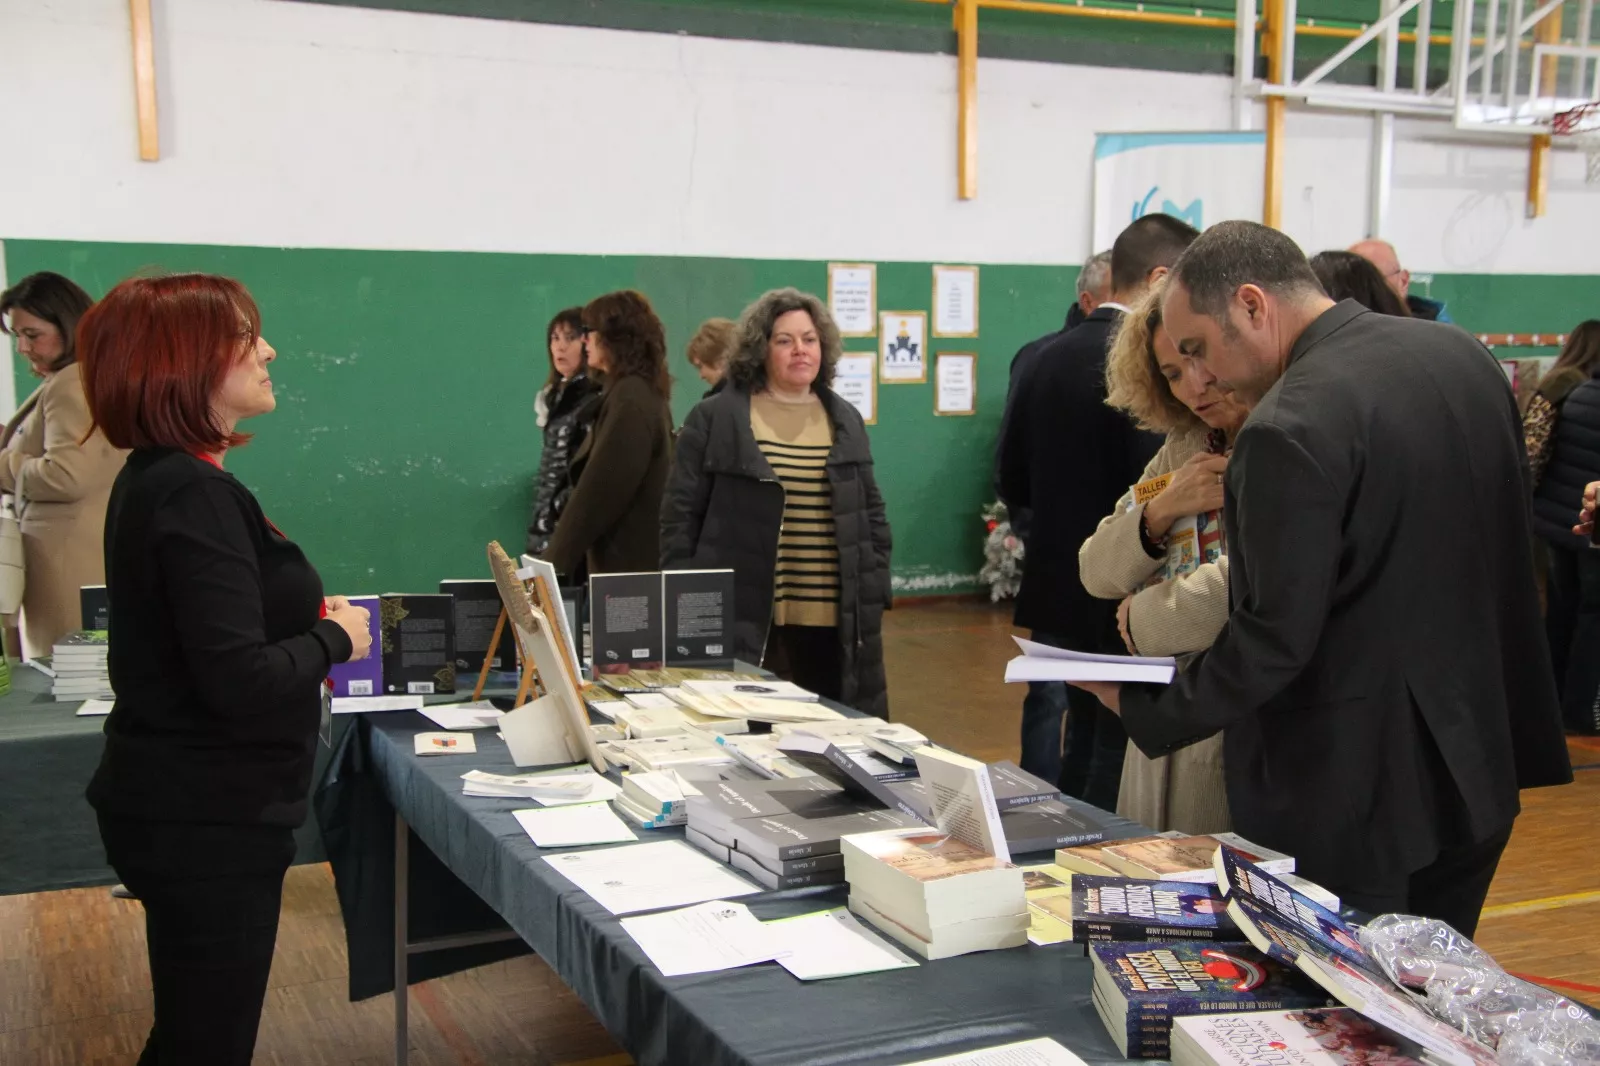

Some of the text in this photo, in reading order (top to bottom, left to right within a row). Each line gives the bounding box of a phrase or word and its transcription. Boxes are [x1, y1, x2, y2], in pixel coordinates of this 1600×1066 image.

[1138, 480, 1167, 496] TALLER
[1057, 836, 1077, 844] Agujero
[1099, 886, 1127, 914] CUANDO
[1125, 884, 1155, 918] APRENDAS
[1153, 891, 1180, 911] AMAR
[1193, 930, 1213, 938] CUANDO
[1152, 950, 1187, 971] MUNDO
[1168, 971, 1192, 979] EL
[1180, 960, 1215, 981] LO VEA
[1173, 979, 1201, 992] QUE
[1246, 1001, 1256, 1009] QUE
[1258, 1001, 1282, 1009] PAYASEA,
[1253, 1020, 1284, 1041] CLOWN
